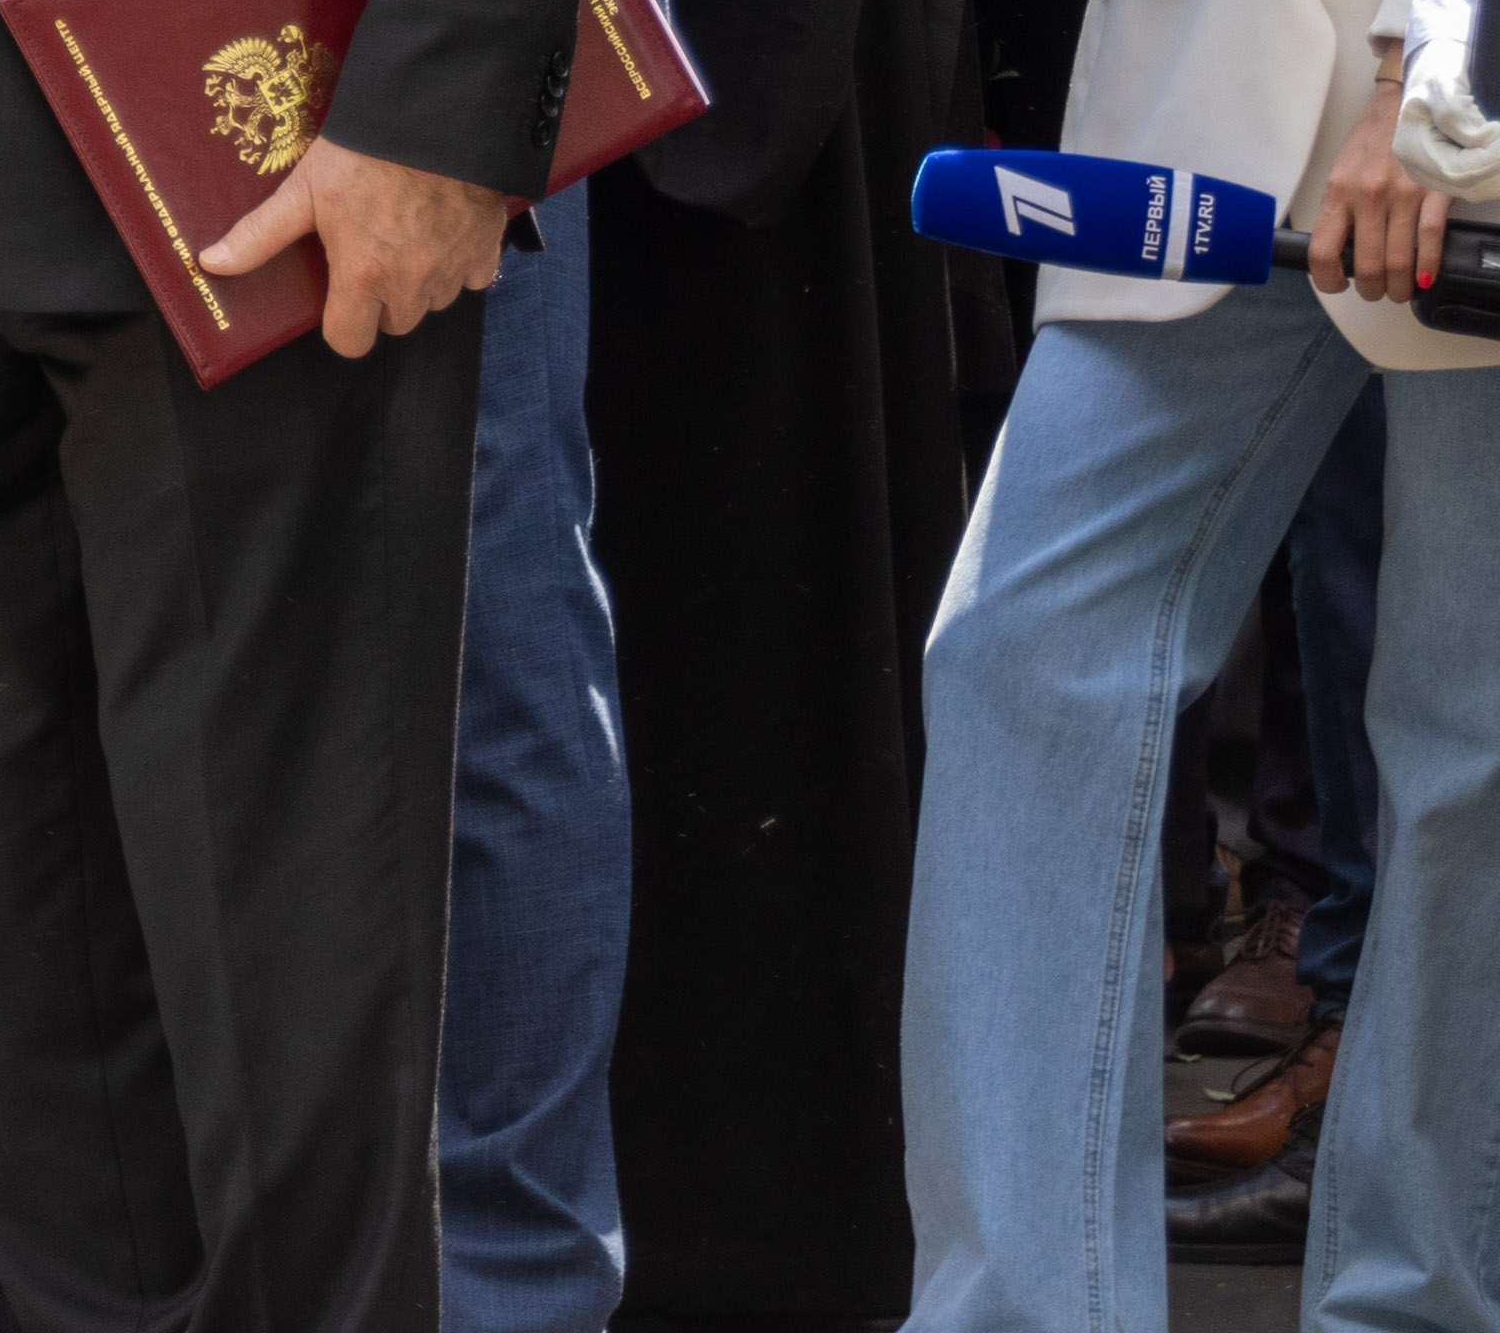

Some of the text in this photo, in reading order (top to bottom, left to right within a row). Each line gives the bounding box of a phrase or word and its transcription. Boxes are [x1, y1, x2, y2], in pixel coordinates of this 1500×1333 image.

[593, 4, 652, 100] ВСЕРОССИЙСКИЙ
[54, 19, 230, 331] РОССИЙСКИЙ ФЕДЕРАЛЬНЫЙ ЯДЕРНЫЙ ЦЕНТР
[1141, 175, 1166, 261] ПЕРВЫЙ
[1193, 194, 1215, 255] 1TV.RU
